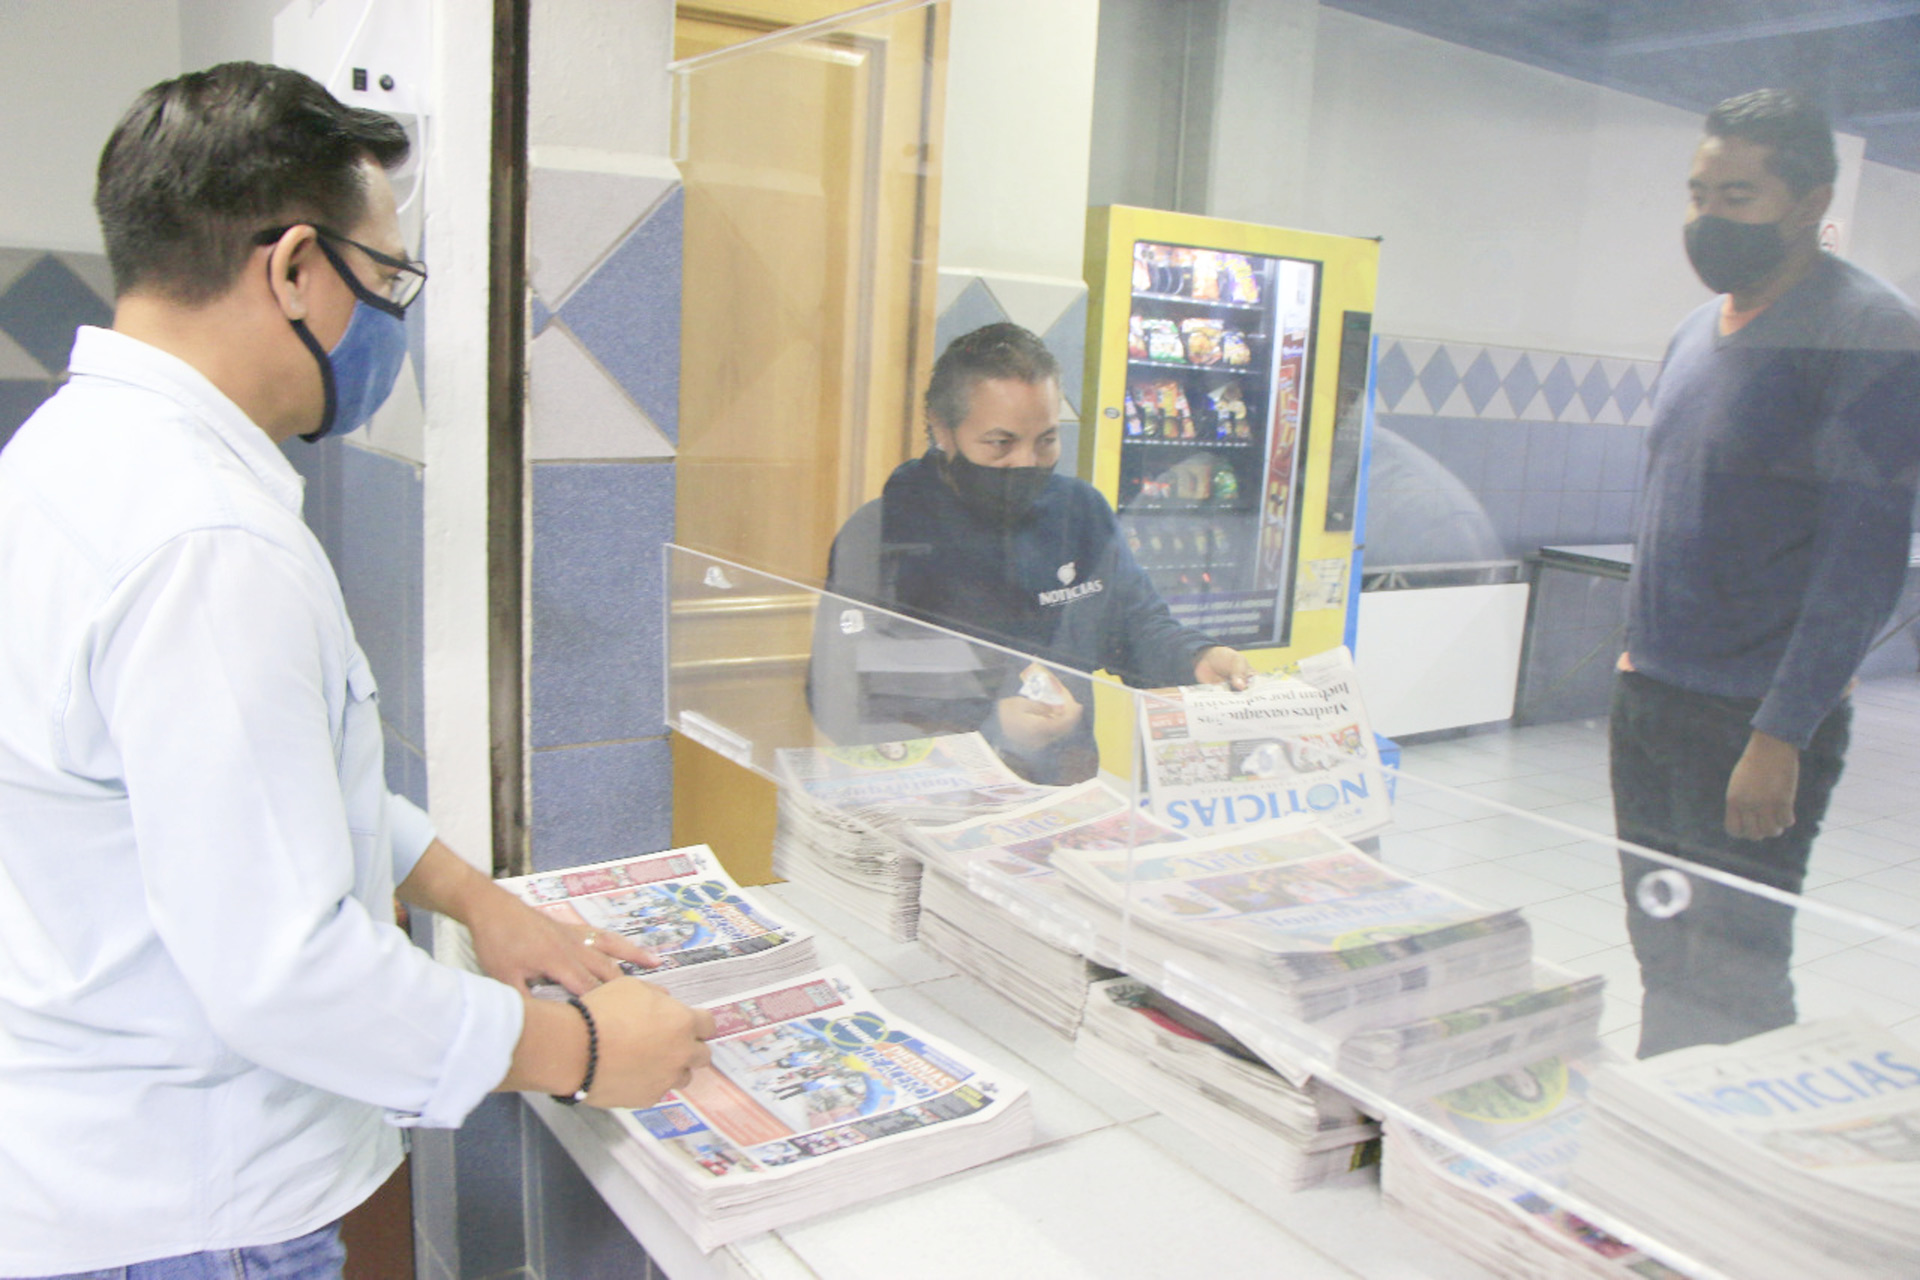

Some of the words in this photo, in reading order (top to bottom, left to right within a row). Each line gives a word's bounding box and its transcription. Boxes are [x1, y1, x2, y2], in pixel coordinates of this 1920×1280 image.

[1038, 579, 1104, 606] NOTICIAS
[1291, 702, 1349, 721] Madres
[1166, 773, 1369, 829] NOTICIAS
[889, 1044, 952, 1091] PIERNAS
[1672, 1051, 1920, 1118] NOTICIAS
